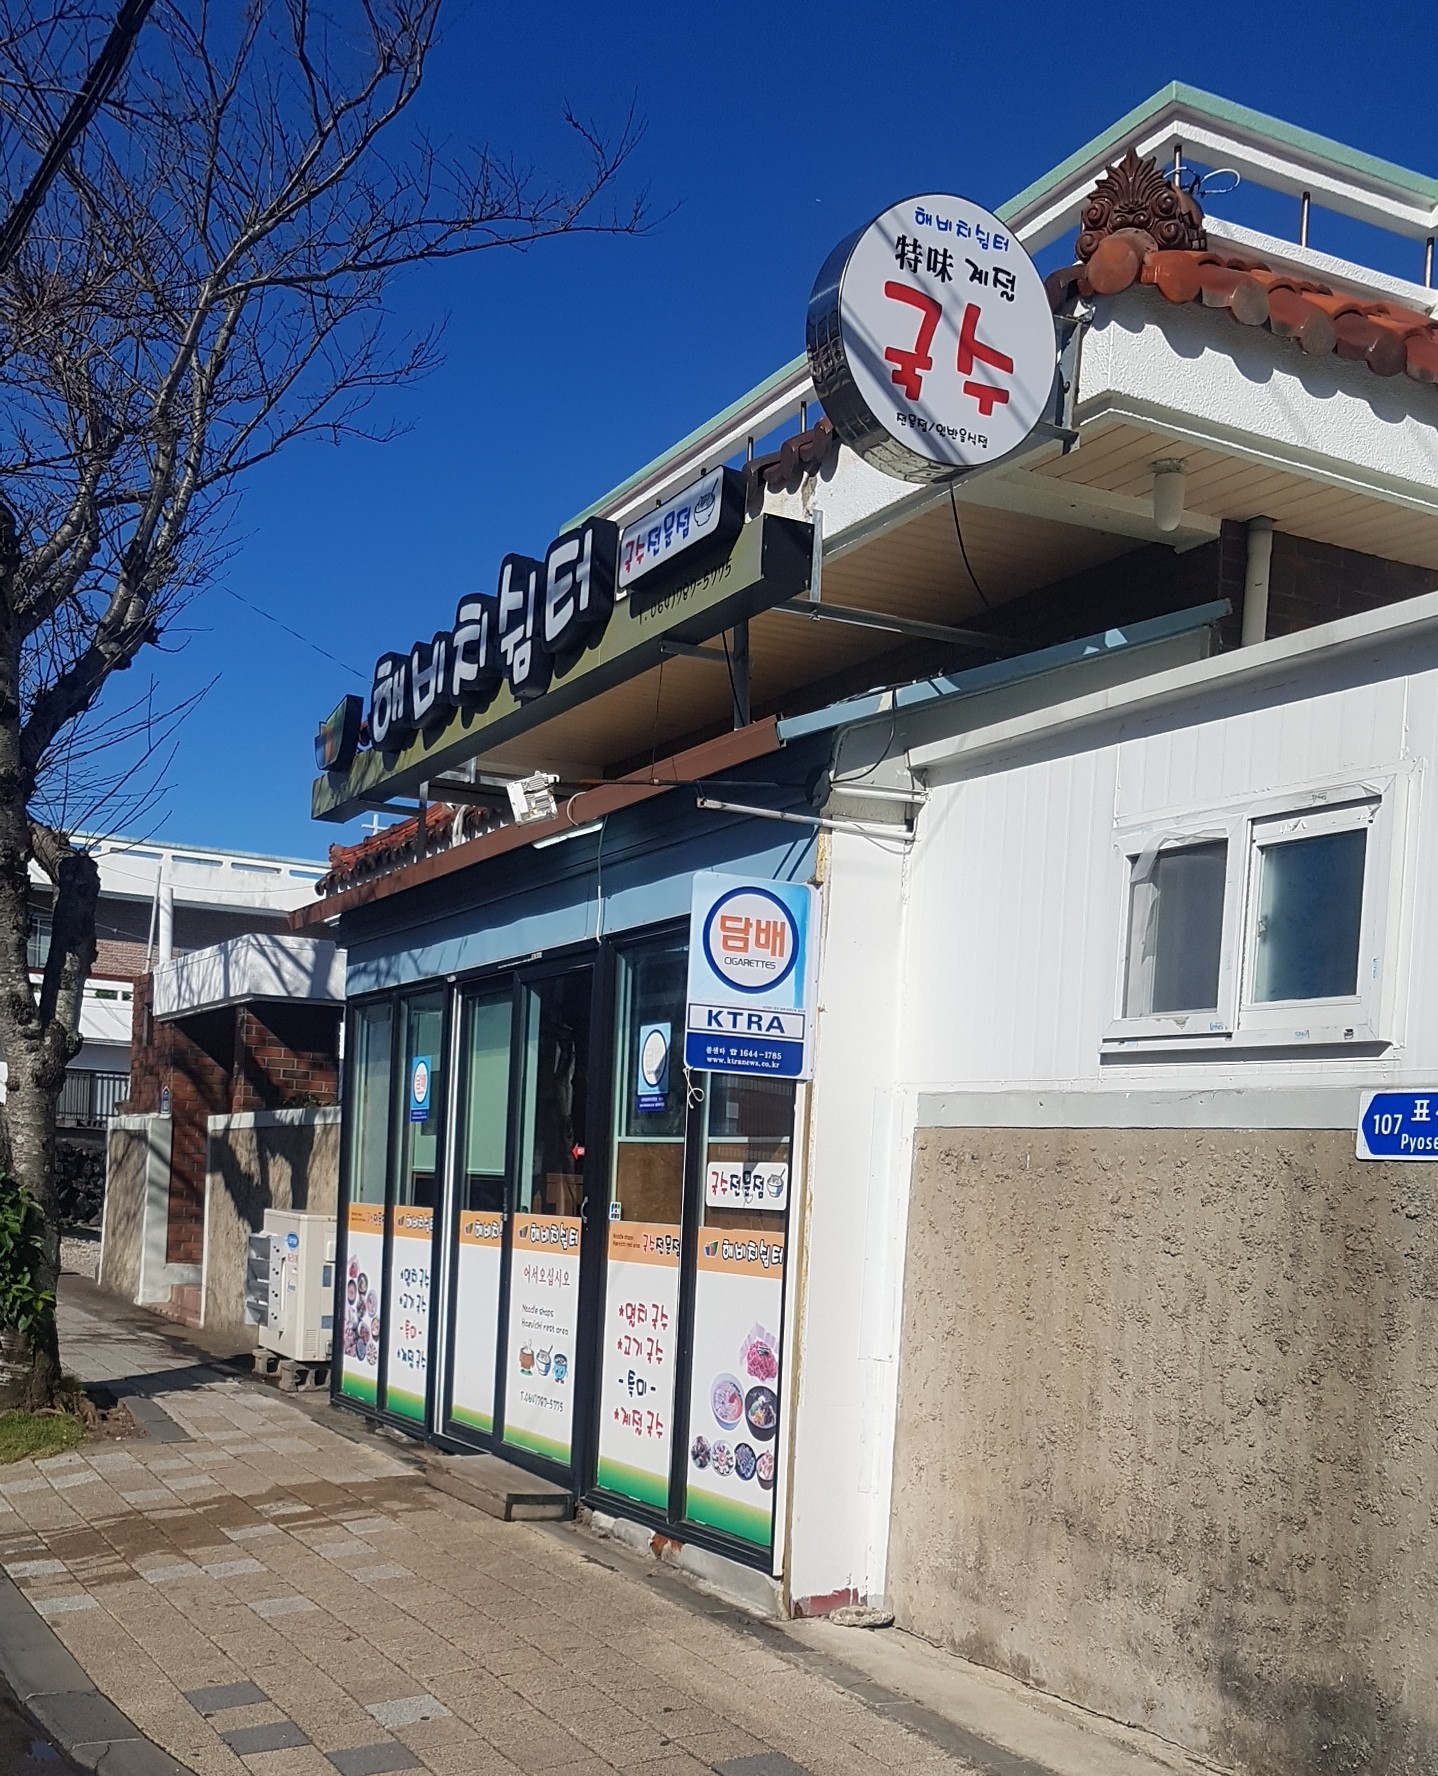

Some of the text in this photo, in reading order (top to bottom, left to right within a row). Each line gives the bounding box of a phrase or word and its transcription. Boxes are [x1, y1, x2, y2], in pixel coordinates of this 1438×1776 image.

[914, 206, 1010, 252] 해비치쉼터
[895, 234, 1017, 302] 特味 계절
[884, 280, 1014, 416] 국수
[373, 528, 593, 744] 해비치쉼터
[719, 914, 787, 958] 담배
[707, 1009, 786, 1034] KTRA
[740, 1049, 783, 1061] 1644-1785
[1373, 1114, 1404, 1135] 107
[1411, 1100, 1438, 1121] 표
[475, 1219, 503, 1239] 해비치
[529, 1222, 580, 1250] 해비치쉼터
[722, 1239, 783, 1268] 해비치쉼터
[523, 1264, 571, 1288] 어서오십시오
[651, 1303, 669, 1331] 국수
[646, 1337, 664, 1365] 국수
[646, 1410, 664, 1439] 국수
